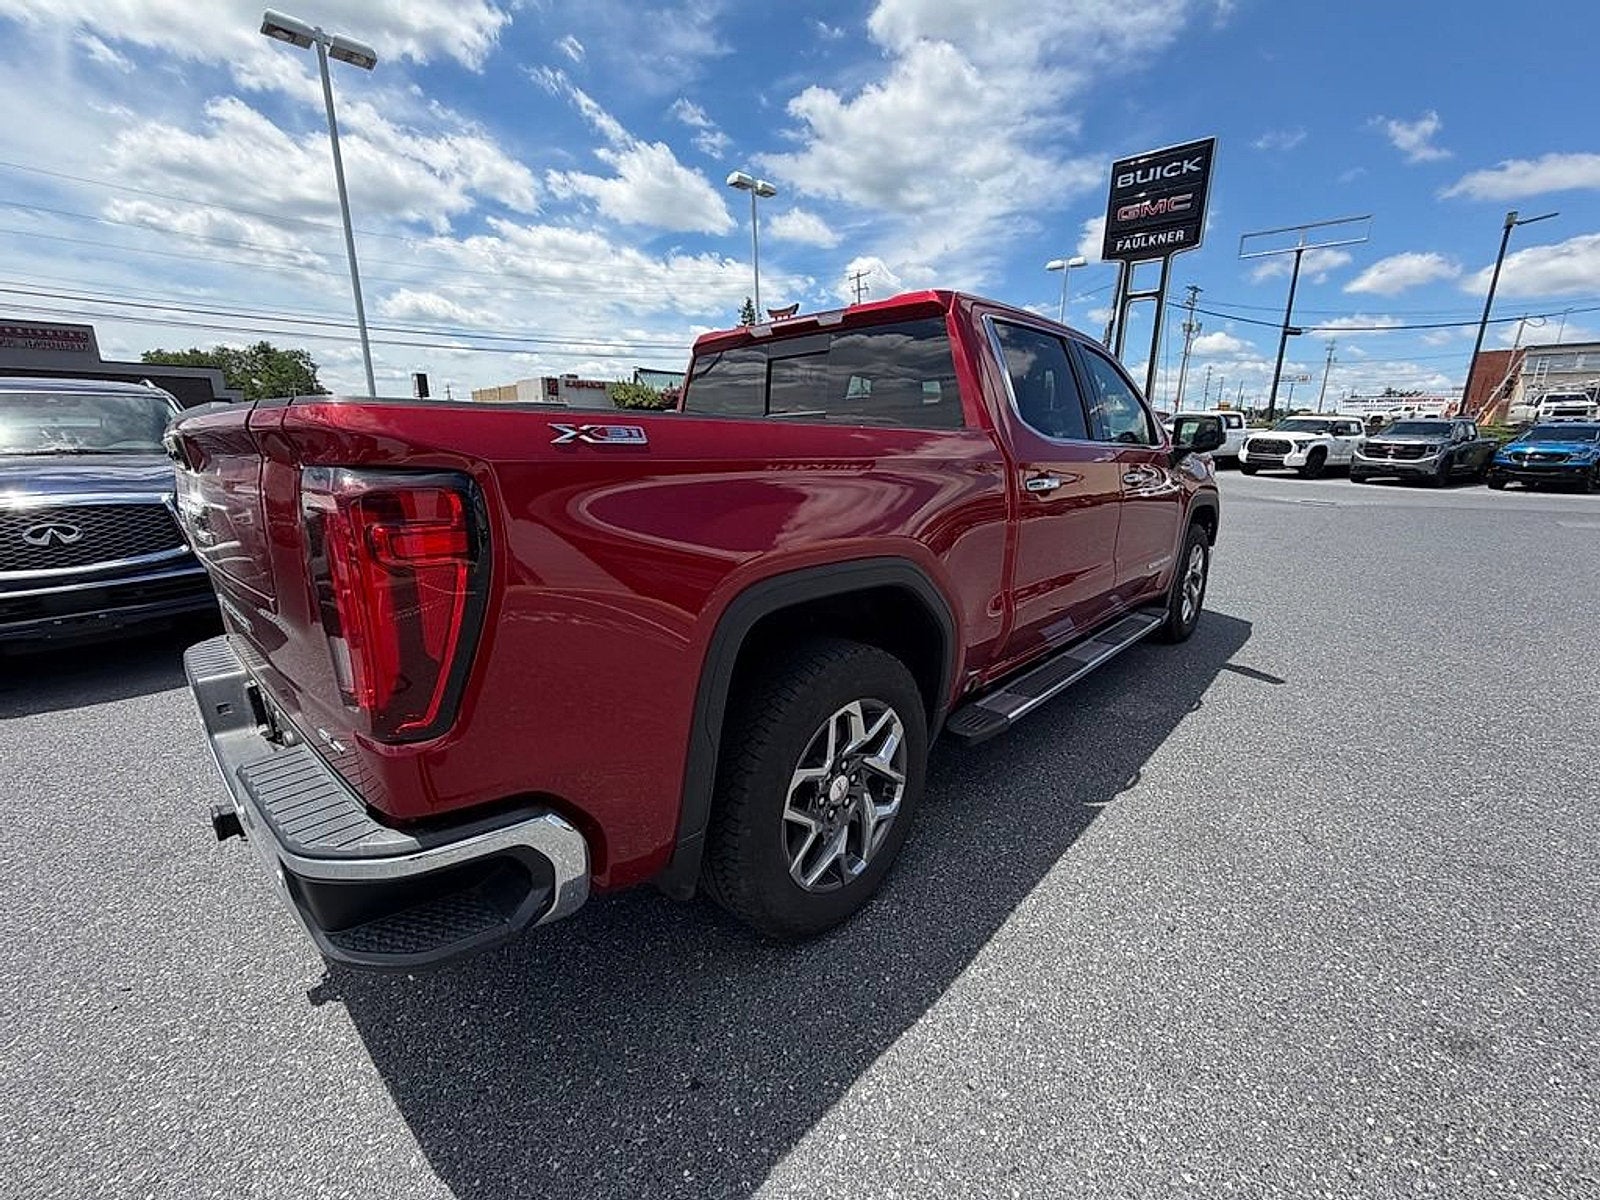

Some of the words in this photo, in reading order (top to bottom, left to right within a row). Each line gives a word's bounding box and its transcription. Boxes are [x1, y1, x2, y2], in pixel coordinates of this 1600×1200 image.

[1117, 156, 1203, 188] BUICK
[1117, 192, 1194, 221] GMC
[1115, 229, 1185, 251] FAULKNER
